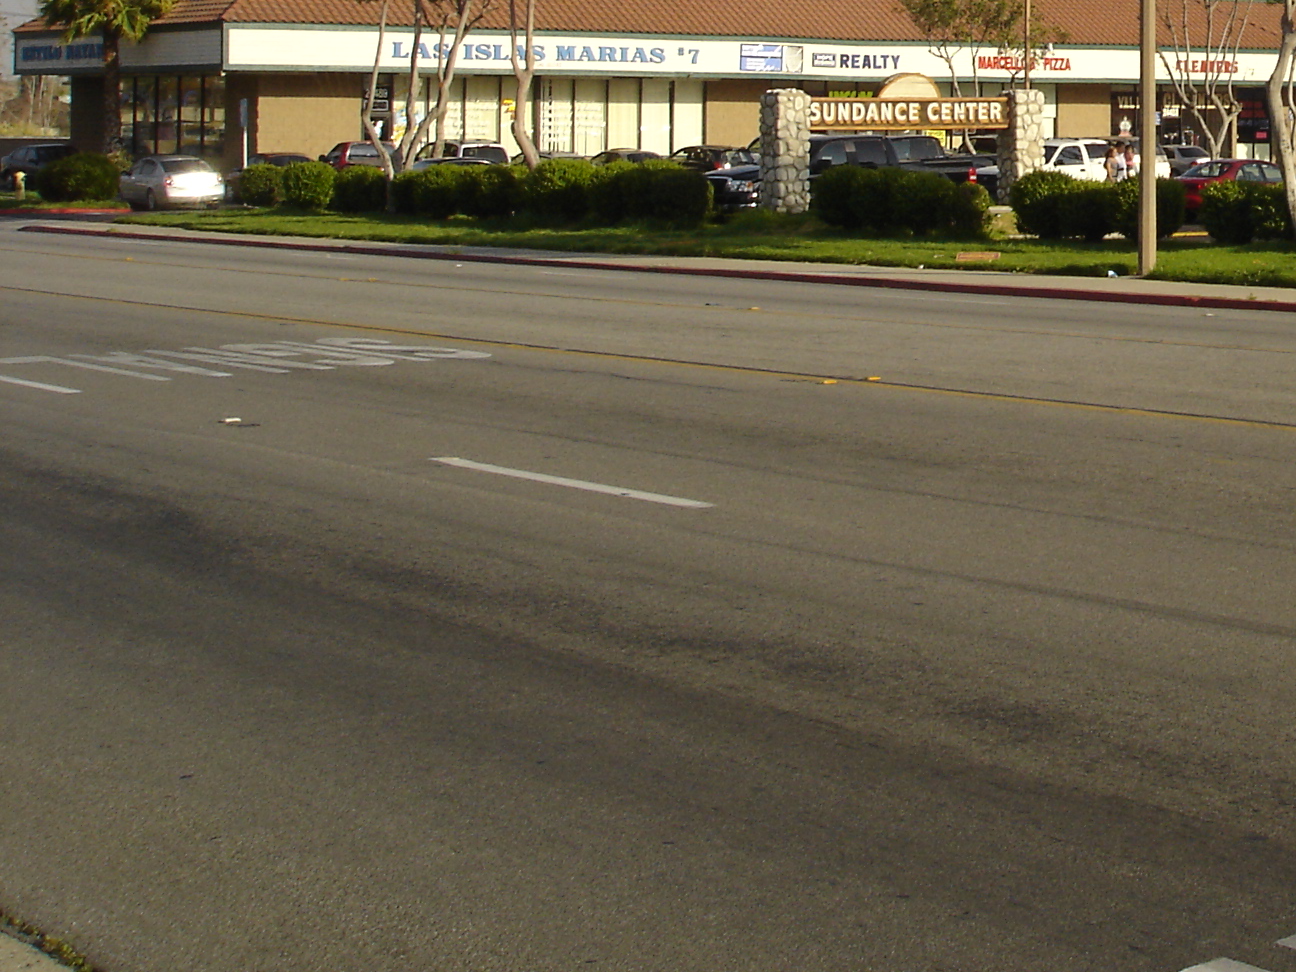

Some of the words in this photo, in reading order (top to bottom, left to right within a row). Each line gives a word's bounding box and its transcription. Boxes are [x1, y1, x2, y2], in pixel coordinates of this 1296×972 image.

[392, 42, 449, 59] LAS
[464, 44, 546, 61] ISLAS
[556, 45, 666, 63] MARIAS
[839, 53, 901, 70] REALTY
[1043, 57, 1072, 71] PIZZA
[810, 102, 920, 124] SUNDANCE
[926, 102, 1002, 123] CENTER
